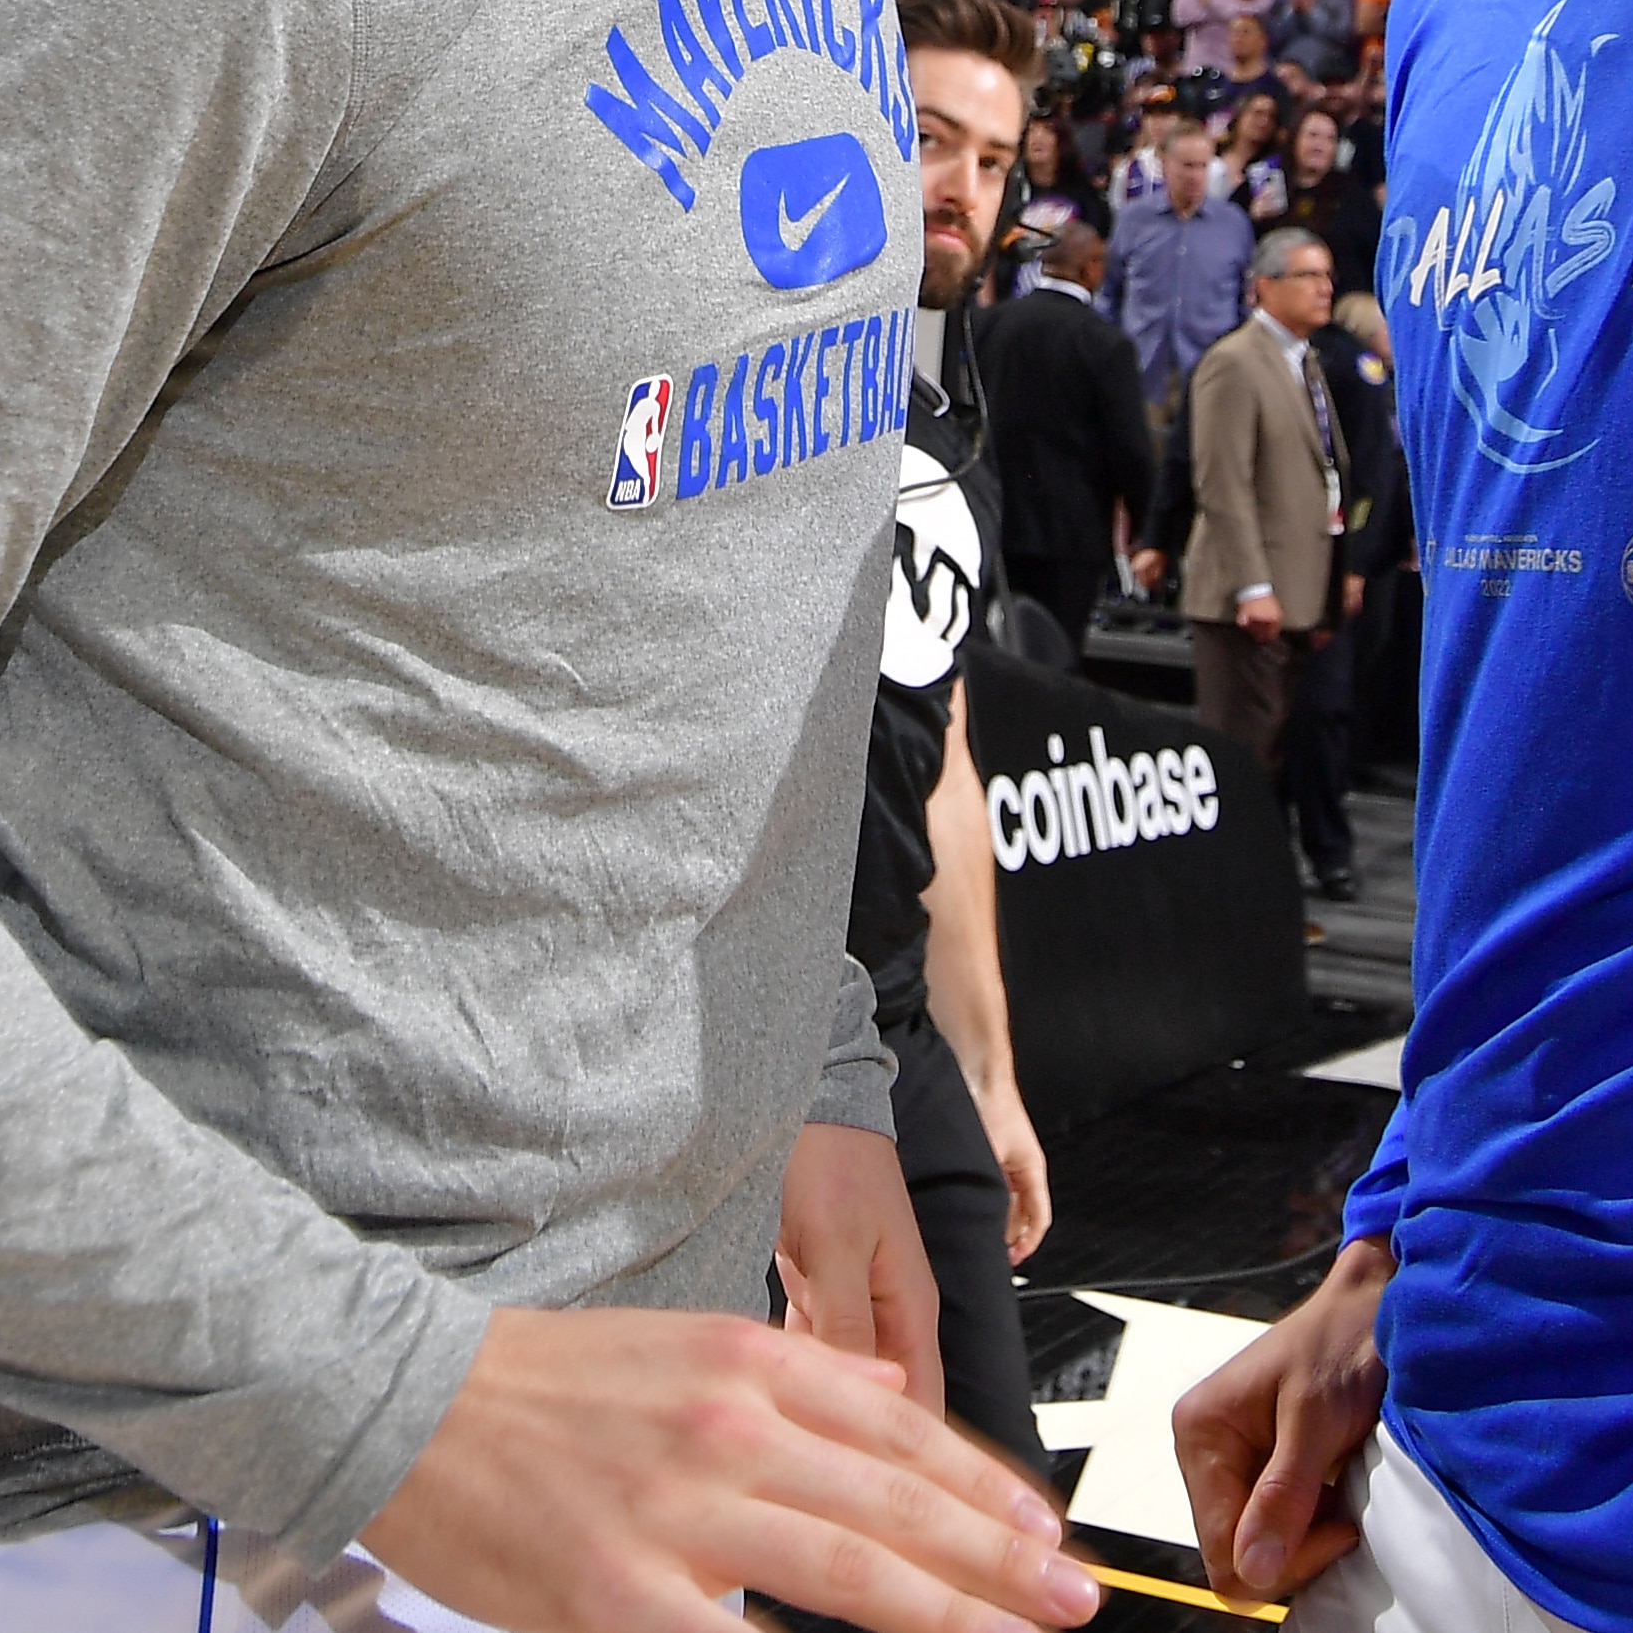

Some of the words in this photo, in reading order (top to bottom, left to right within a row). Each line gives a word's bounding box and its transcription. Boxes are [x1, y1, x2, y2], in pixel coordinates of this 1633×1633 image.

[614, 478, 642, 503] NBA
[1479, 548, 1583, 573] MAVERICKS
[1480, 578, 1511, 597] 2022
[987, 725, 1219, 872] coinbase
